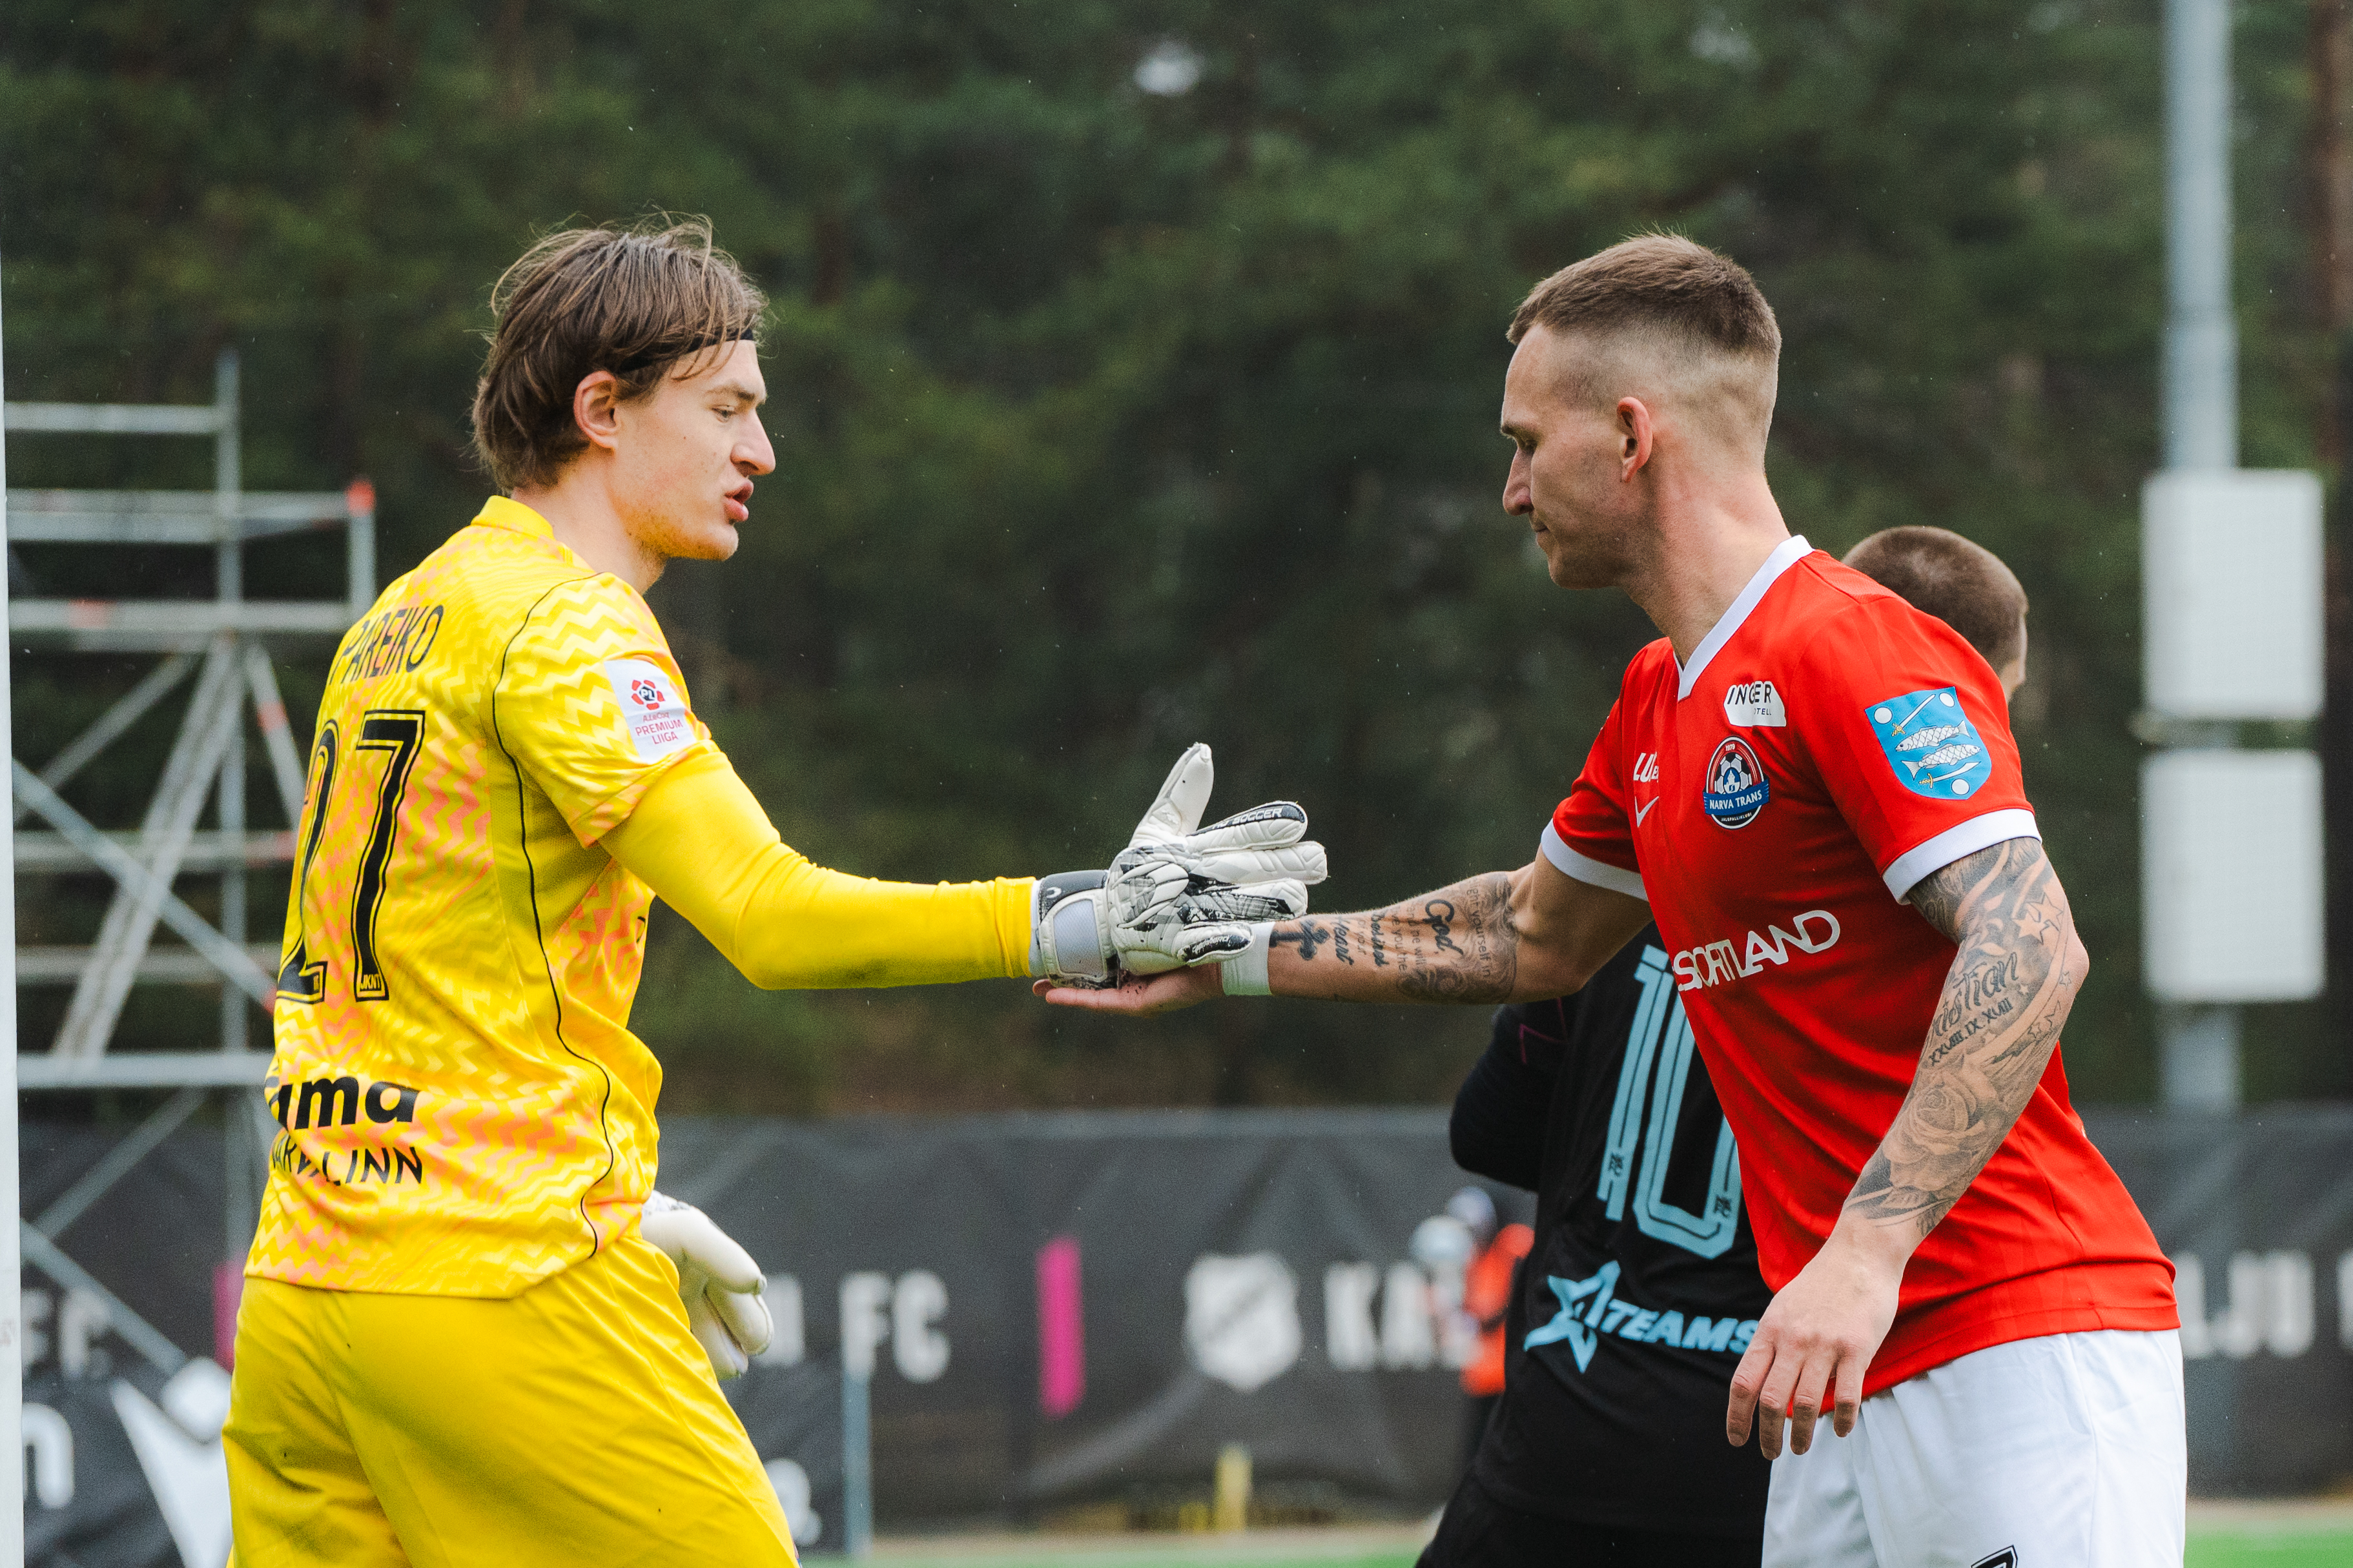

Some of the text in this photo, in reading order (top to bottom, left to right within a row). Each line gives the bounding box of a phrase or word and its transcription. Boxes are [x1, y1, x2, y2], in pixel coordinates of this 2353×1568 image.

[329, 604, 444, 686] PAREIKO
[1753, 708, 1772, 716] TELL
[635, 719, 683, 736] PREMIUM
[652, 731, 679, 745] LIIGA
[1709, 789, 1762, 810] NARVA TRANS
[1232, 808, 1283, 826] SOCCER
[1330, 915, 1355, 966] Heart
[1391, 929, 1404, 950] you
[1469, 909, 1492, 962] yourself
[1396, 952, 1409, 971] the
[1672, 910, 1841, 992] SORTLAND
[360, 973, 380, 990] JKNT
[1596, 944, 1743, 1259] 10
[839, 1270, 951, 1383] FC
